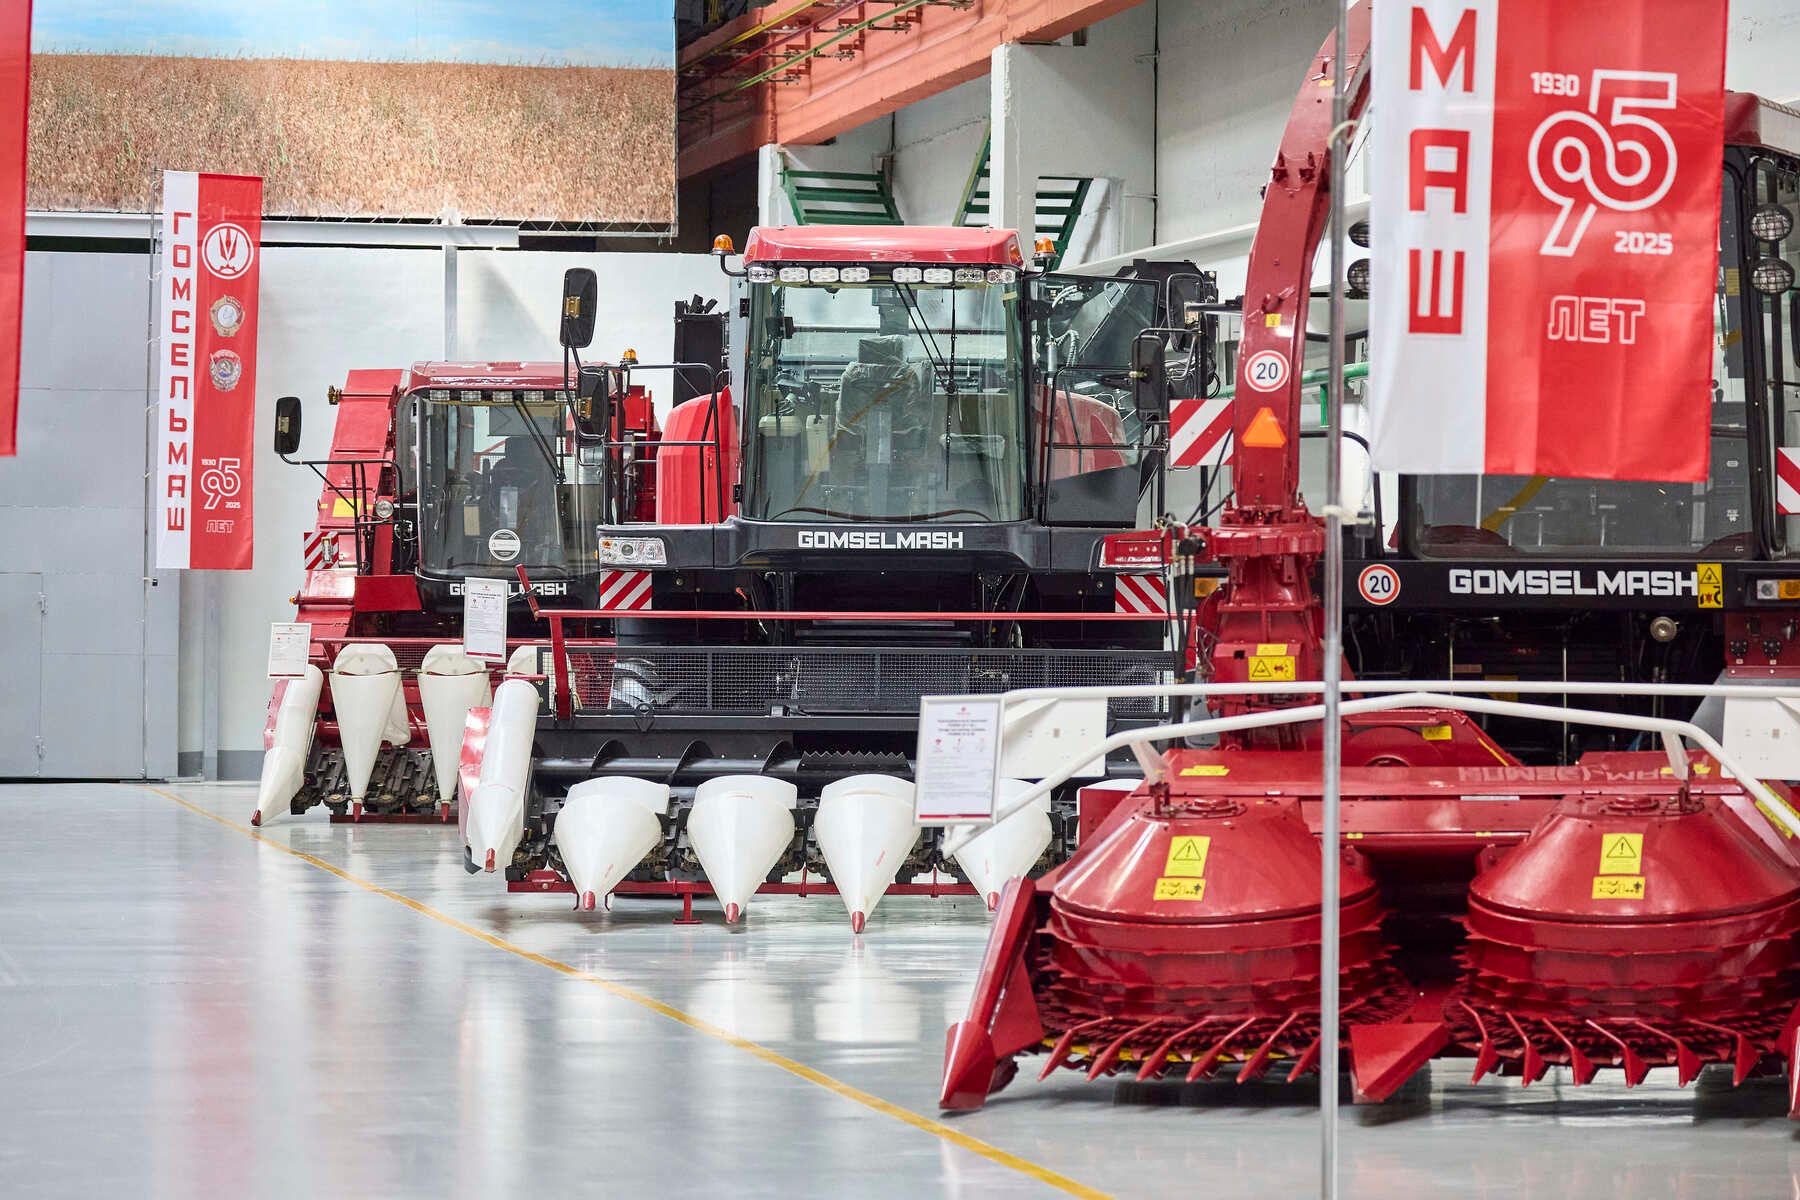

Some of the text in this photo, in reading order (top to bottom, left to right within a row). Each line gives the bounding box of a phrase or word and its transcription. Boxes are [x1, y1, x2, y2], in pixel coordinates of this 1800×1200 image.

[1530, 72, 1580, 97] 1930
[1528, 68, 1678, 257] 95
[1614, 230, 1674, 256] 2025
[1547, 294, 1646, 345] ЛЕТ
[167, 211, 192, 531] ГОМСЕЛЬМАШ
[1256, 362, 1278, 380] 20
[201, 457, 241, 510] 95
[206, 520, 235, 534] ЛЕТ
[798, 530, 964, 549] GOMSELMASH
[1369, 574, 1392, 594] 20
[1449, 568, 1698, 597] GOMSELMASH
